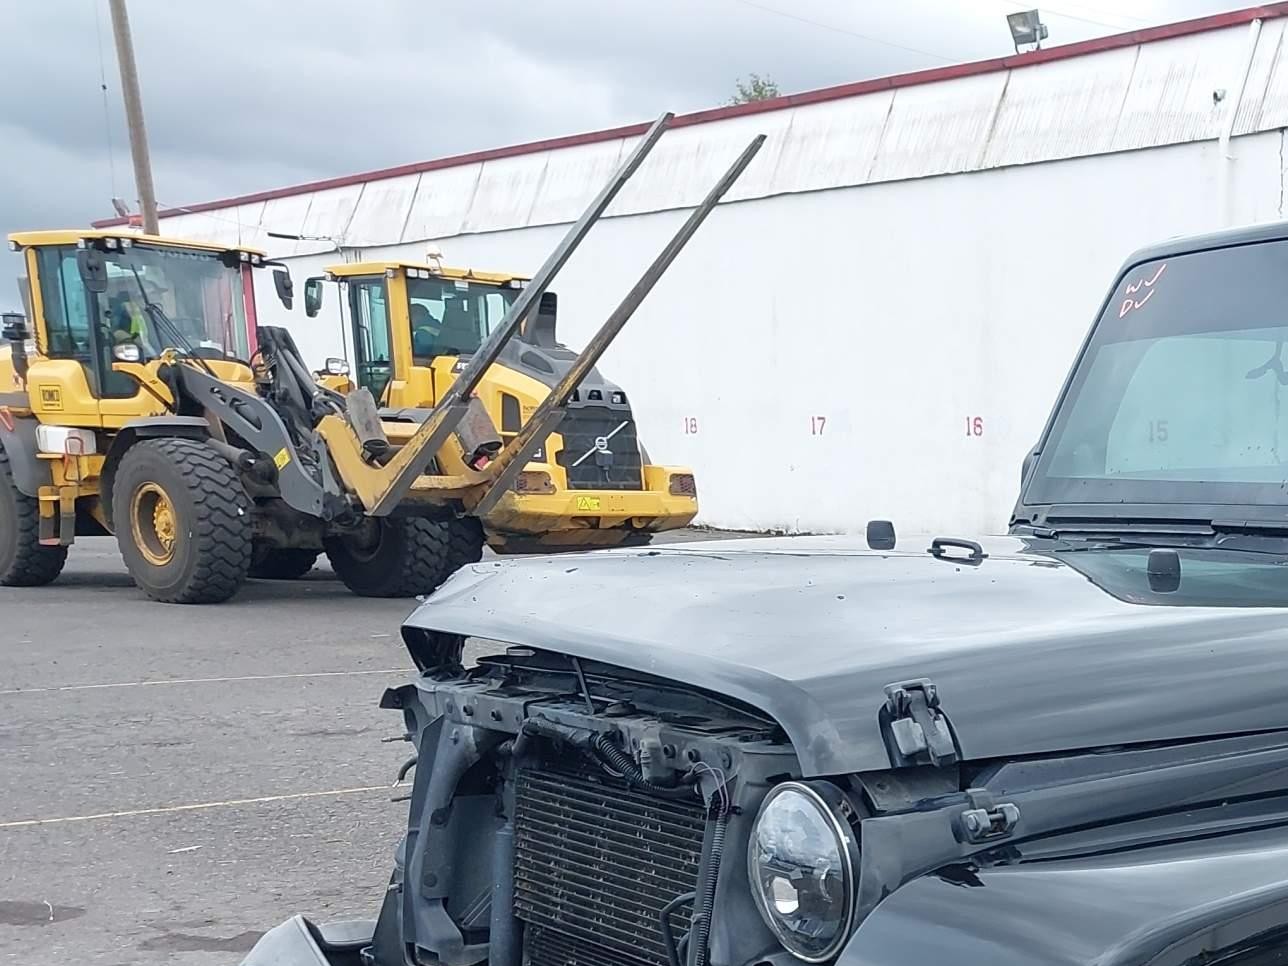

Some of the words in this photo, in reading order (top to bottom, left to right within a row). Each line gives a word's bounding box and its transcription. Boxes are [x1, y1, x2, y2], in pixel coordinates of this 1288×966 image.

[684, 416, 698, 435] 18
[811, 416, 827, 436] 17
[965, 416, 984, 437] 16
[1148, 420, 1169, 443] 15
